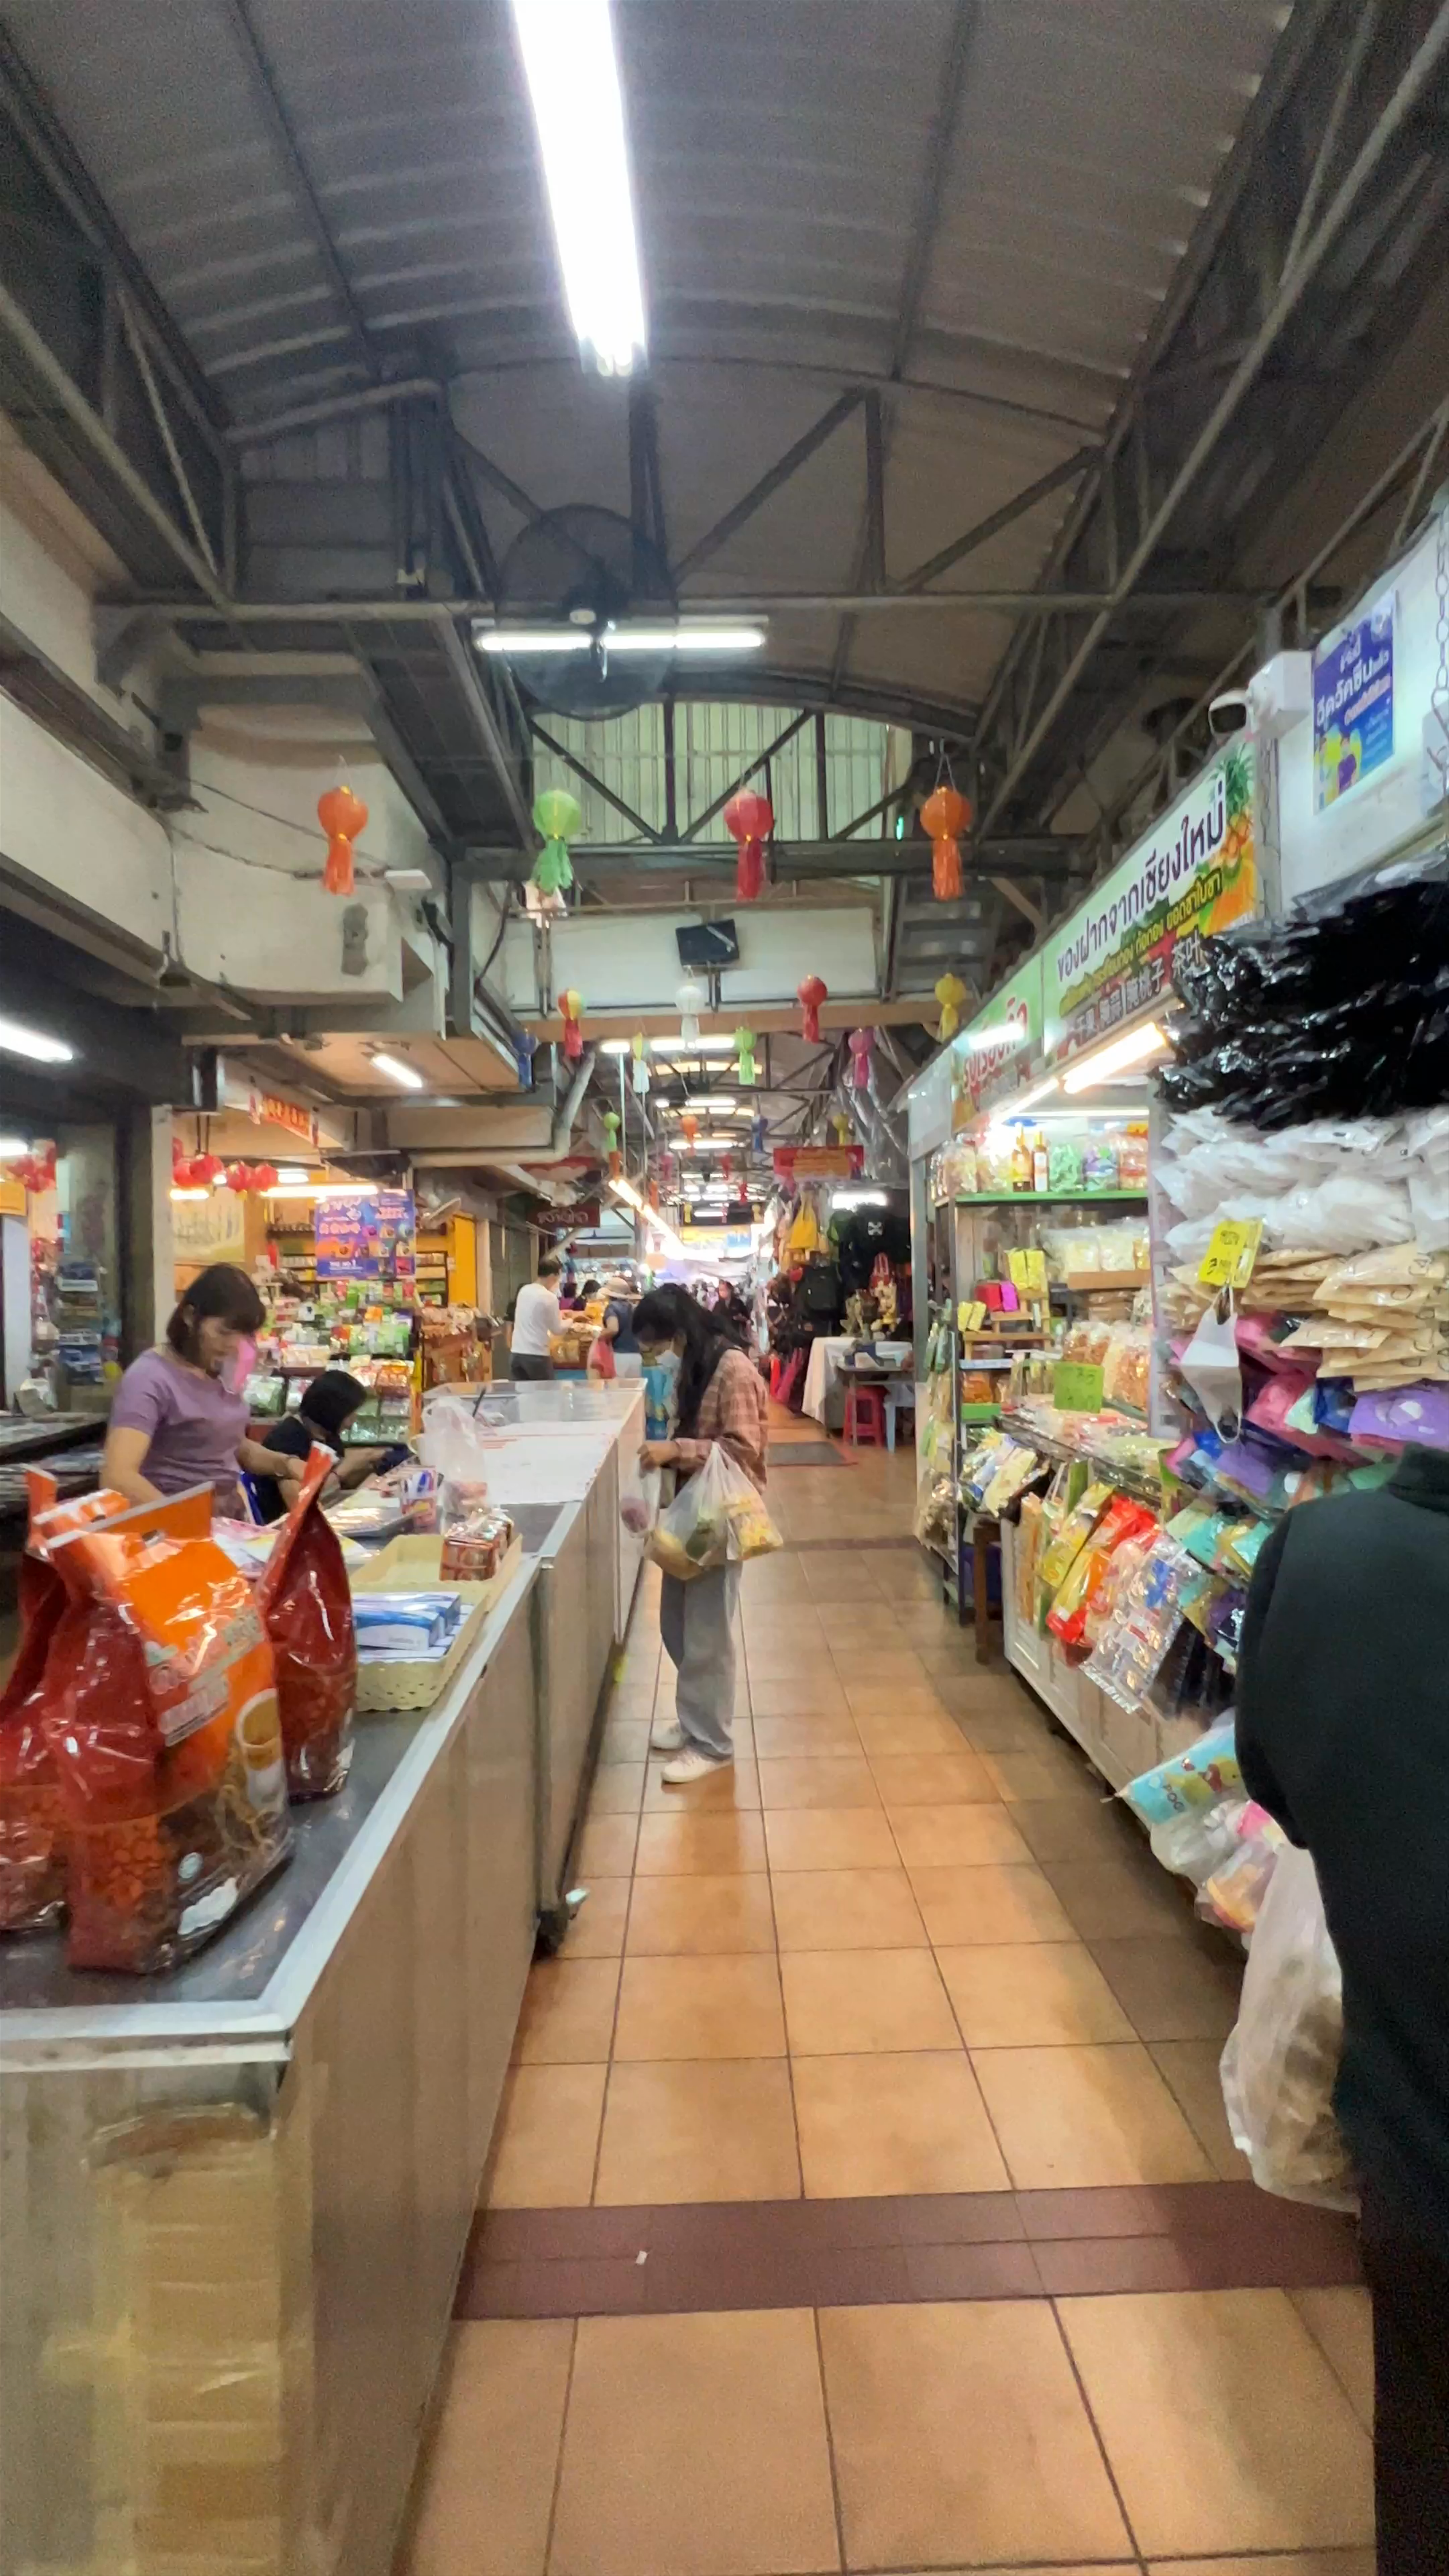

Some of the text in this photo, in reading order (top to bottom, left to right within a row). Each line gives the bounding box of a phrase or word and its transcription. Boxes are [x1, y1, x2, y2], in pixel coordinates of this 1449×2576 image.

[1058, 779, 1223, 983] ของฝากจากเชียงใหม่
